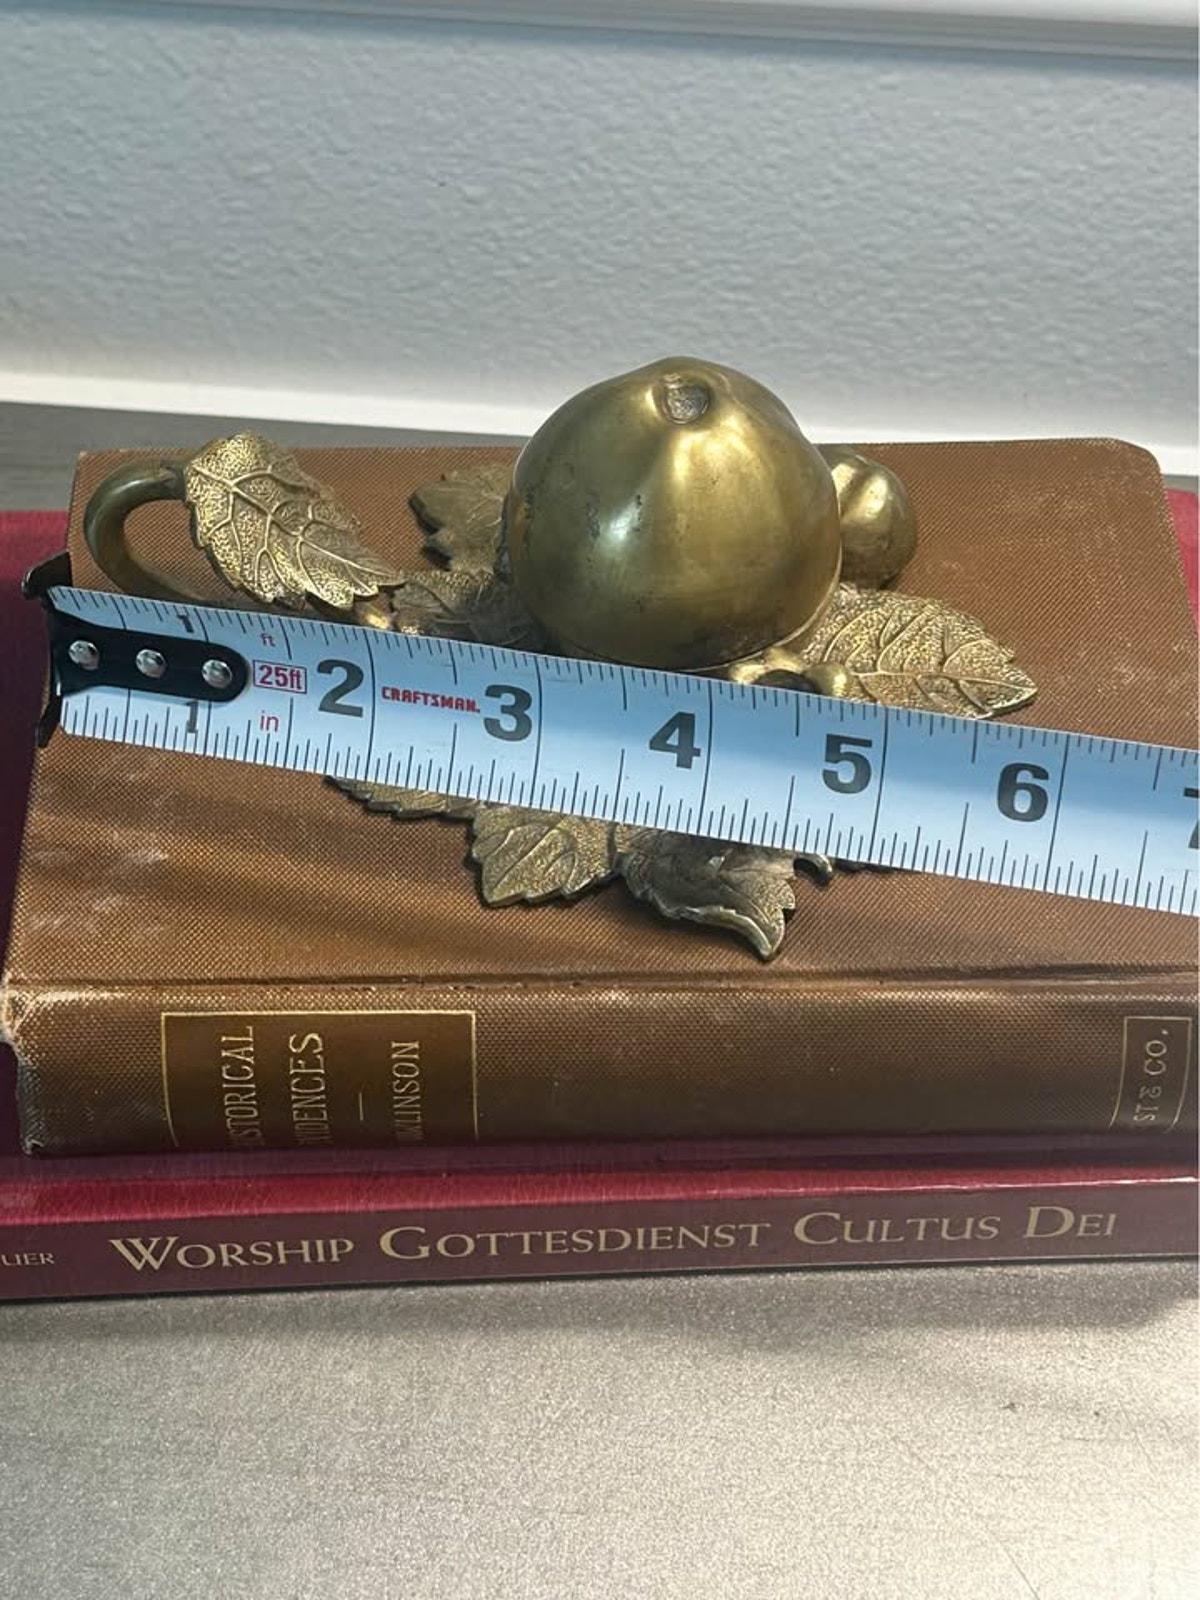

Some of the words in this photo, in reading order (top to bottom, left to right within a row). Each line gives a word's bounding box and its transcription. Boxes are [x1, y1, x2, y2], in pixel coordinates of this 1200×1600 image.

[260, 633, 276, 647] ft
[259, 664, 302, 690] 25ft
[316, 659, 364, 717] 2
[260, 709, 279, 732] in
[483, 684, 533, 742] 3
[649, 711, 701, 769] 4
[822, 733, 873, 794] 5
[997, 763, 1050, 822] 6
[108, 1236, 355, 1271] WORSHIP
[379, 1223, 770, 1260] GOTTESDIENST
[794, 1212, 1000, 1246] CULTUS
[1023, 1206, 1118, 1239] DEI
